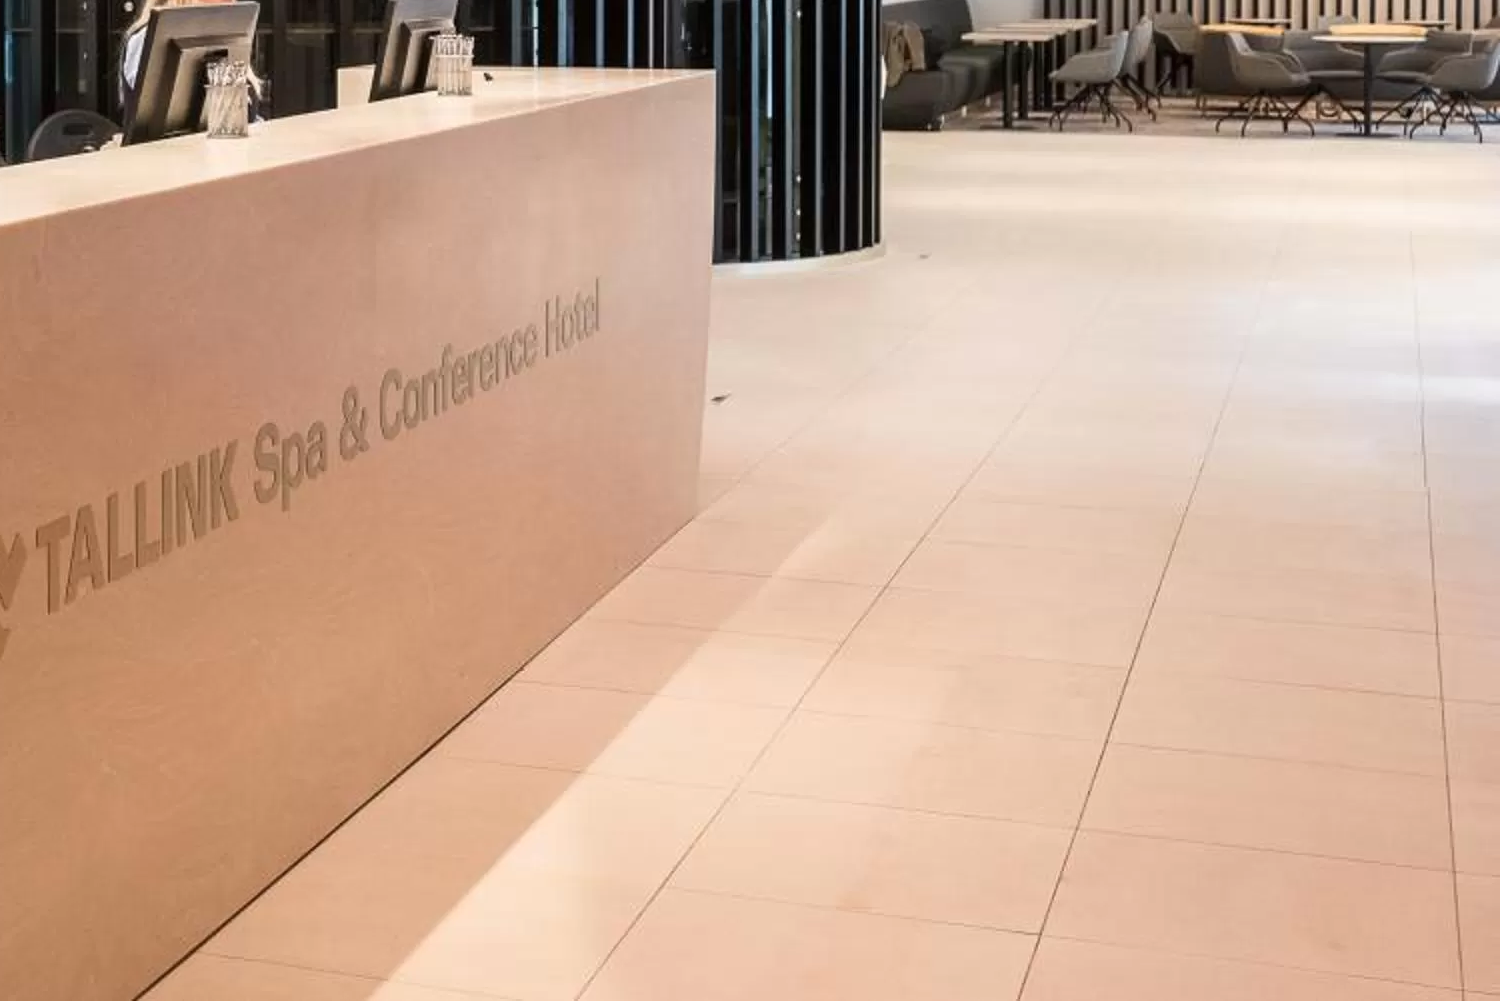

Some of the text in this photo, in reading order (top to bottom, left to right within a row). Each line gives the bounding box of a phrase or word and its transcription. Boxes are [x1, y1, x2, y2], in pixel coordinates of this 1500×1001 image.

[35, 277, 600, 615] TALLINK Spa & Conference Hotel
